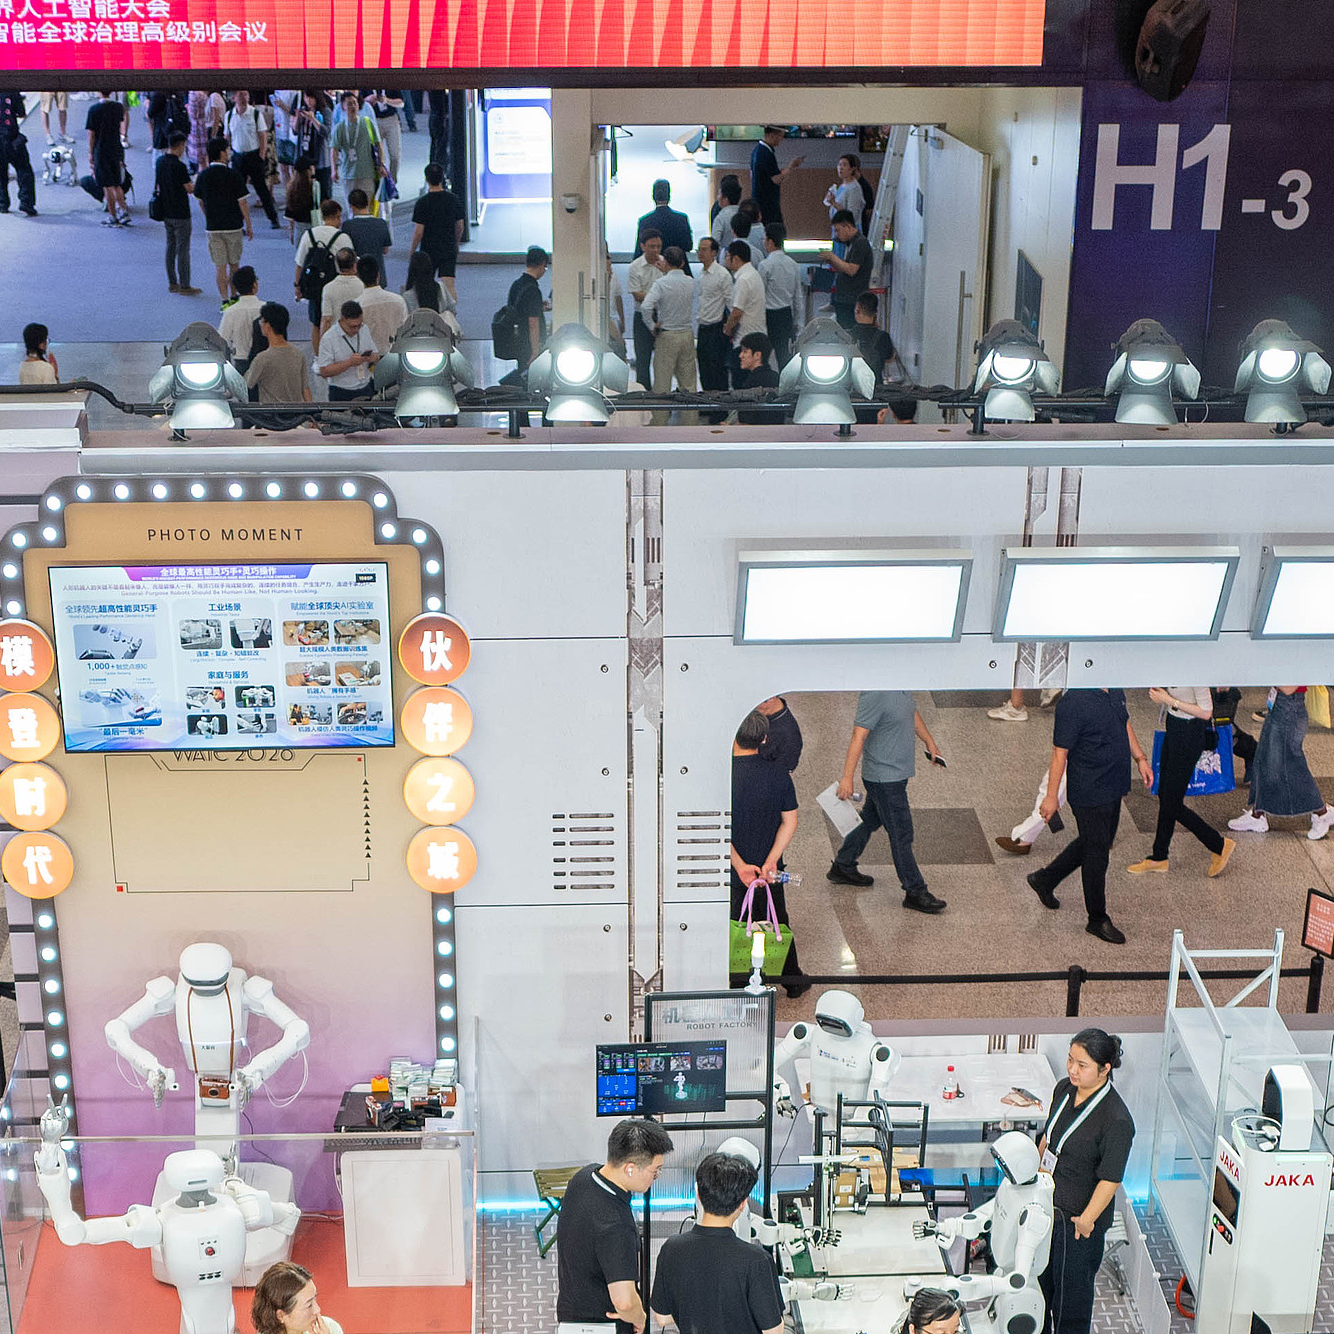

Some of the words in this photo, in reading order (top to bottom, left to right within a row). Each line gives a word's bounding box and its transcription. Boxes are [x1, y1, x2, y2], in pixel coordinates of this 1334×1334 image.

[147, 528, 211, 541] PHOTO
[220, 528, 303, 541] MOMENT
[0, 635, 54, 885] 模登时代
[419, 630, 460, 880] 伙伴之城
[718, 1021, 757, 1029] FACTORY
[1219, 1151, 1240, 1182] JAKA
[1264, 1174, 1315, 1187] JAKA
